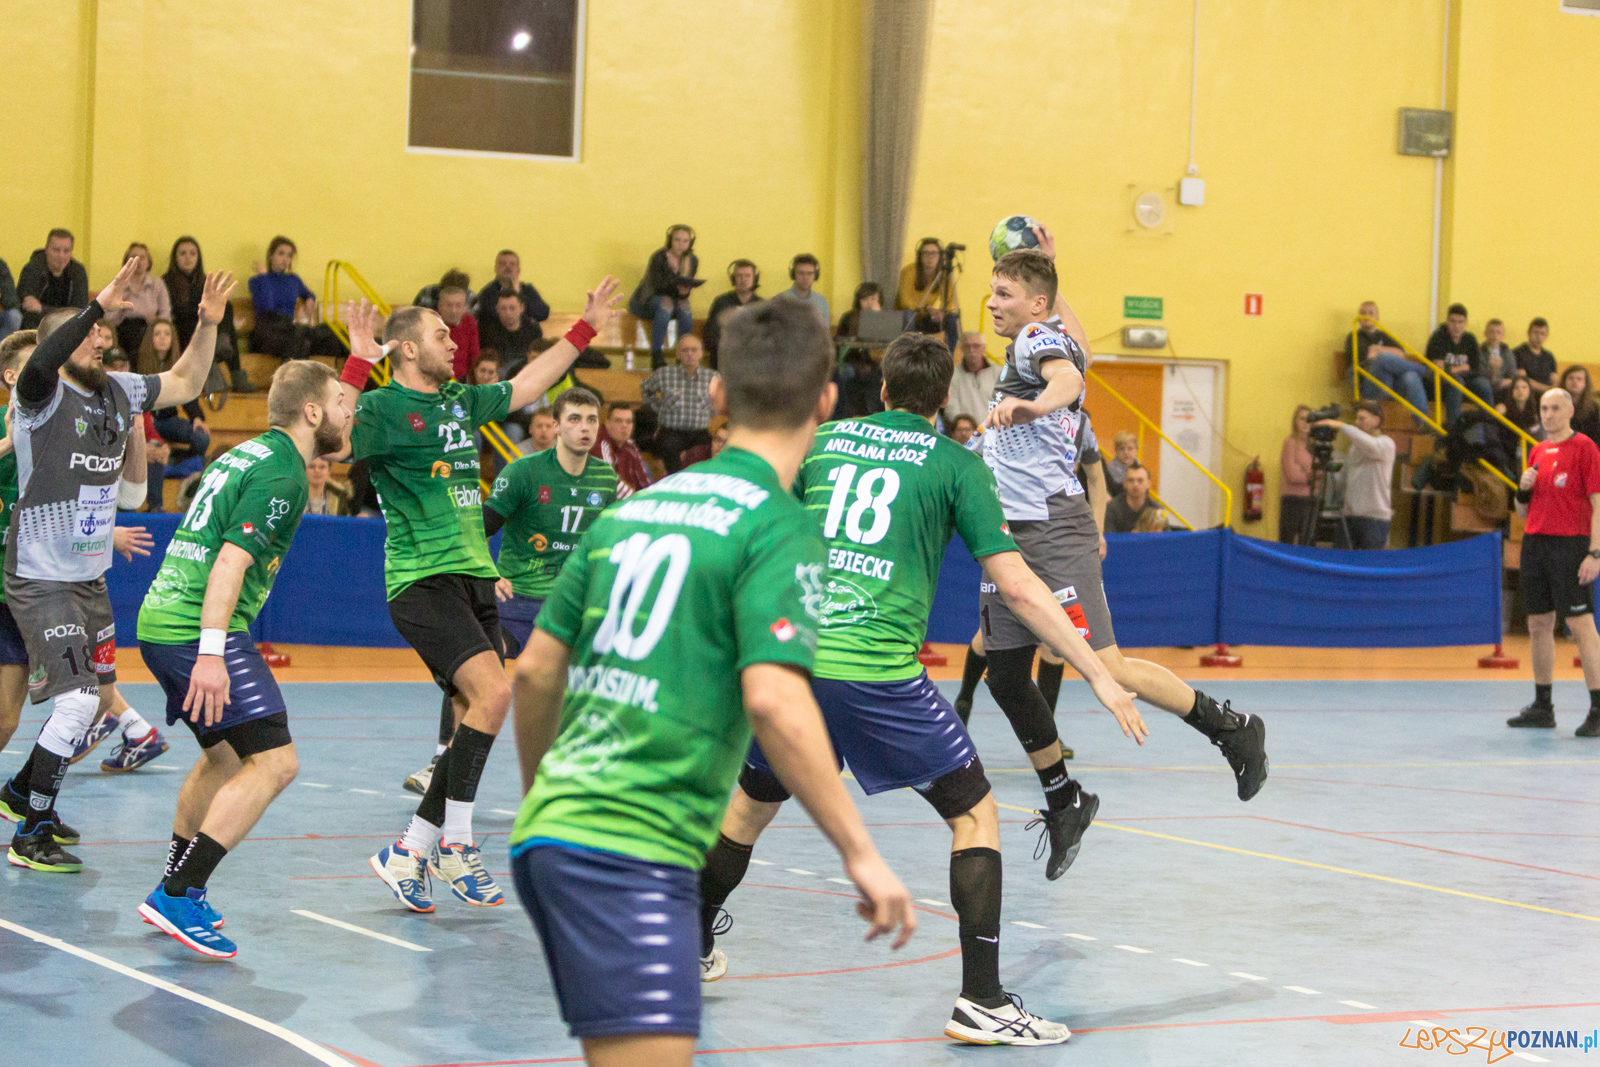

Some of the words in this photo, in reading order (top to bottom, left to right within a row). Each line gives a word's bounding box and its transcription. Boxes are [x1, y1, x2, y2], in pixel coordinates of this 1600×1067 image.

[438, 421, 474, 453] 22
[832, 421, 937, 450] POLITECHNIKA
[823, 438, 886, 461] ANILANA
[887, 444, 928, 467] ŁÓDŹ
[182, 467, 230, 532] 13
[823, 463, 900, 545] 18
[560, 505, 584, 534] 17
[552, 541, 570, 551] Oko
[592, 532, 692, 662] 10
